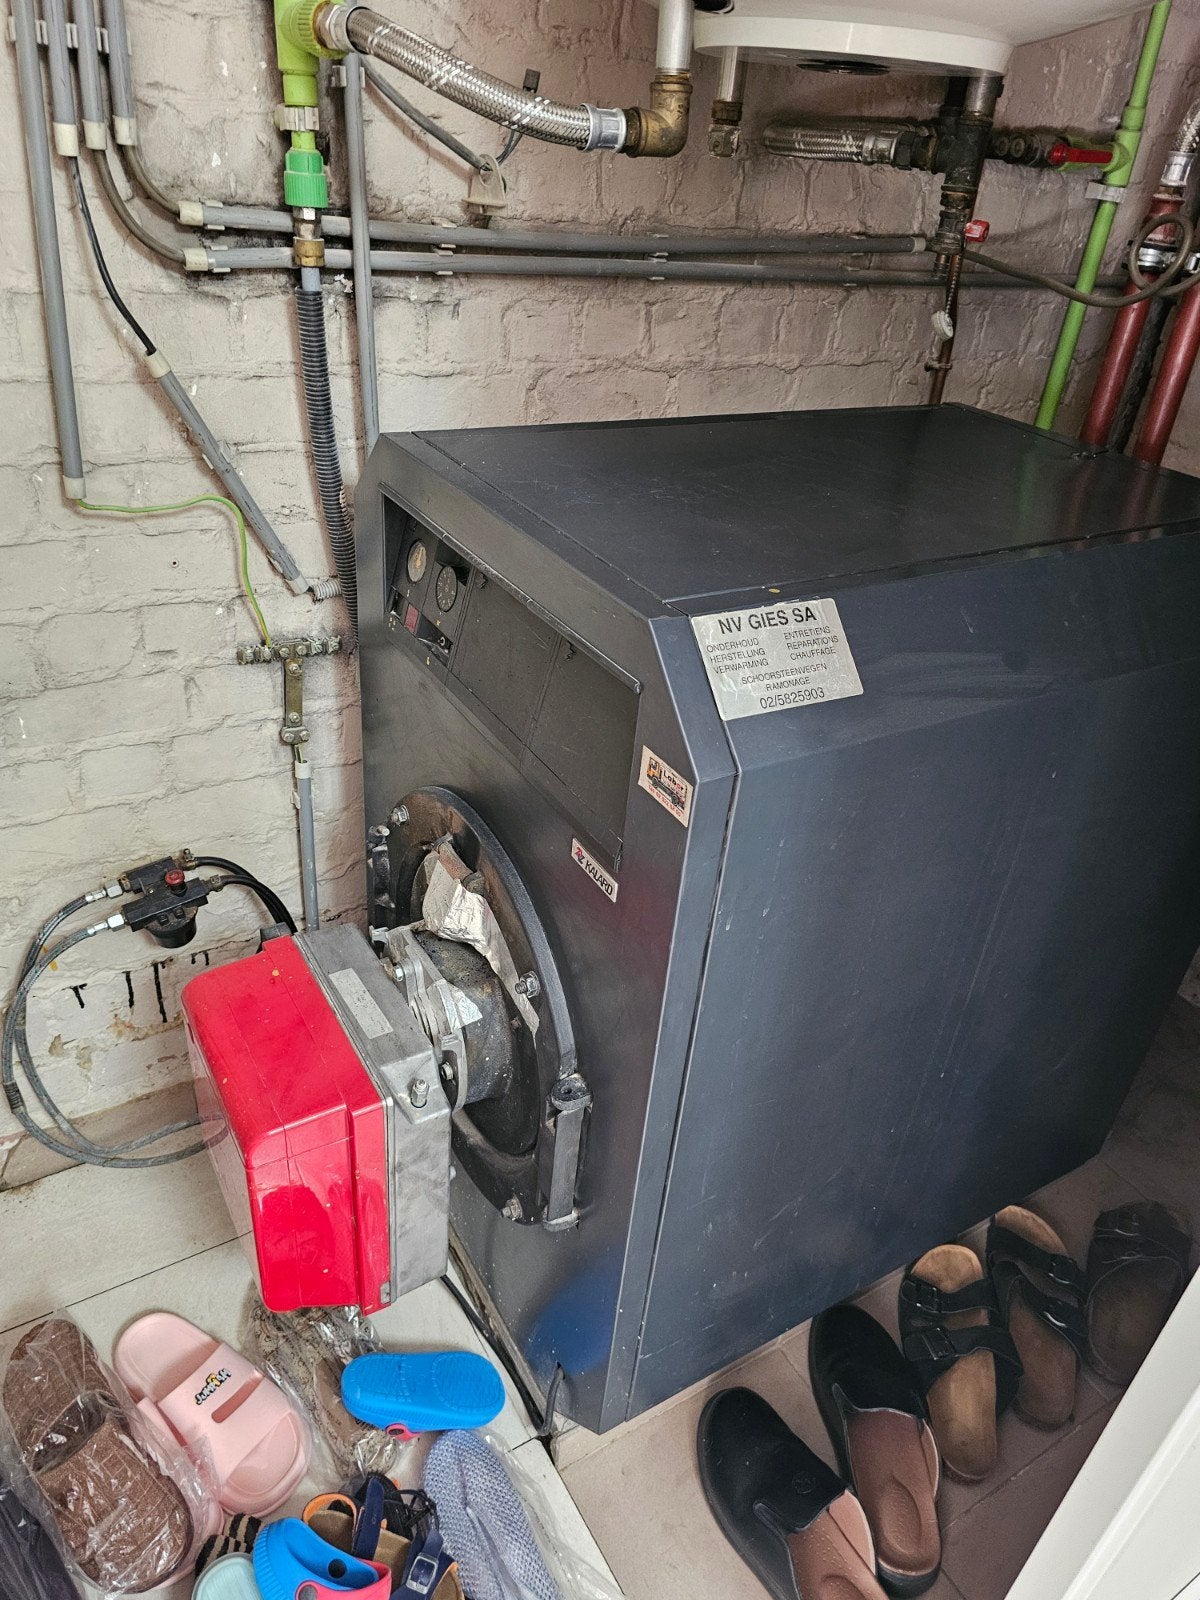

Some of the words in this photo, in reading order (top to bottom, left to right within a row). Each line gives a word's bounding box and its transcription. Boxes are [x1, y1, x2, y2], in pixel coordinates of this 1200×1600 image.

[718, 616, 742, 634] NV
[748, 610, 789, 630] GIES
[792, 606, 817, 623] SA
[783, 626, 831, 639] ENTRETIENS
[706, 637, 759, 652] ONDERHOUD
[786, 635, 839, 650] REPARATIONS
[710, 647, 766, 664] HERSTELLING
[789, 647, 836, 661] CHAUFFAGE
[713, 658, 769, 675] VERWARMING
[741, 663, 828, 685] SCHOORSTEENVEGEN
[765, 677, 811, 692] RAMONAGE
[759, 686, 825, 710] 02/5825903
[585, 860, 613, 896] KALARD
